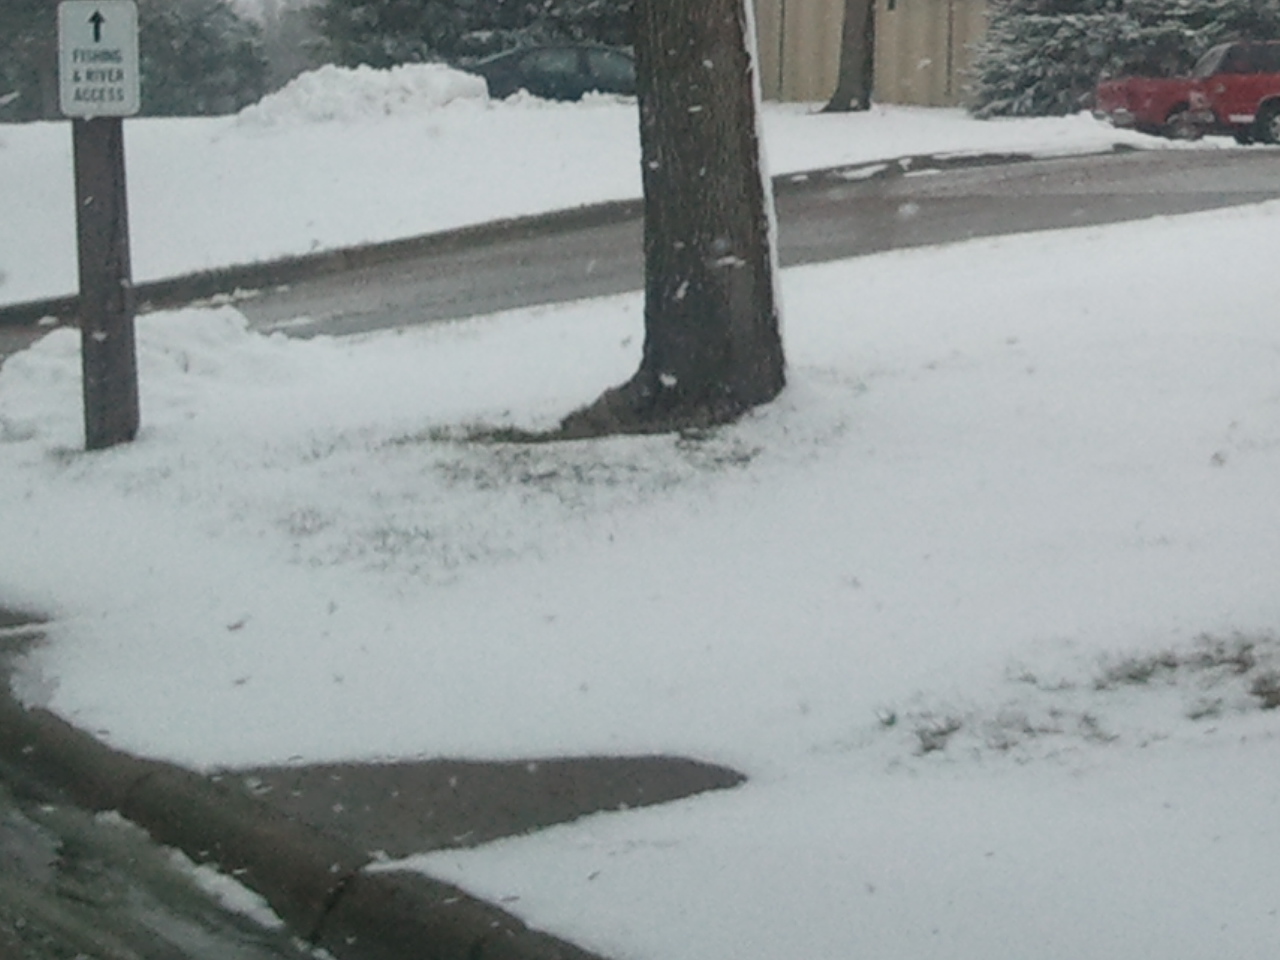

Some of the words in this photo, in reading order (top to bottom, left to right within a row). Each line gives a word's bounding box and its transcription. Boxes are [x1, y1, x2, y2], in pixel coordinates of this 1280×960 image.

[72, 48, 123, 64] FISHING
[73, 68, 81, 83] &
[86, 68, 124, 83] RIVER
[73, 87, 125, 103] ACCESS
